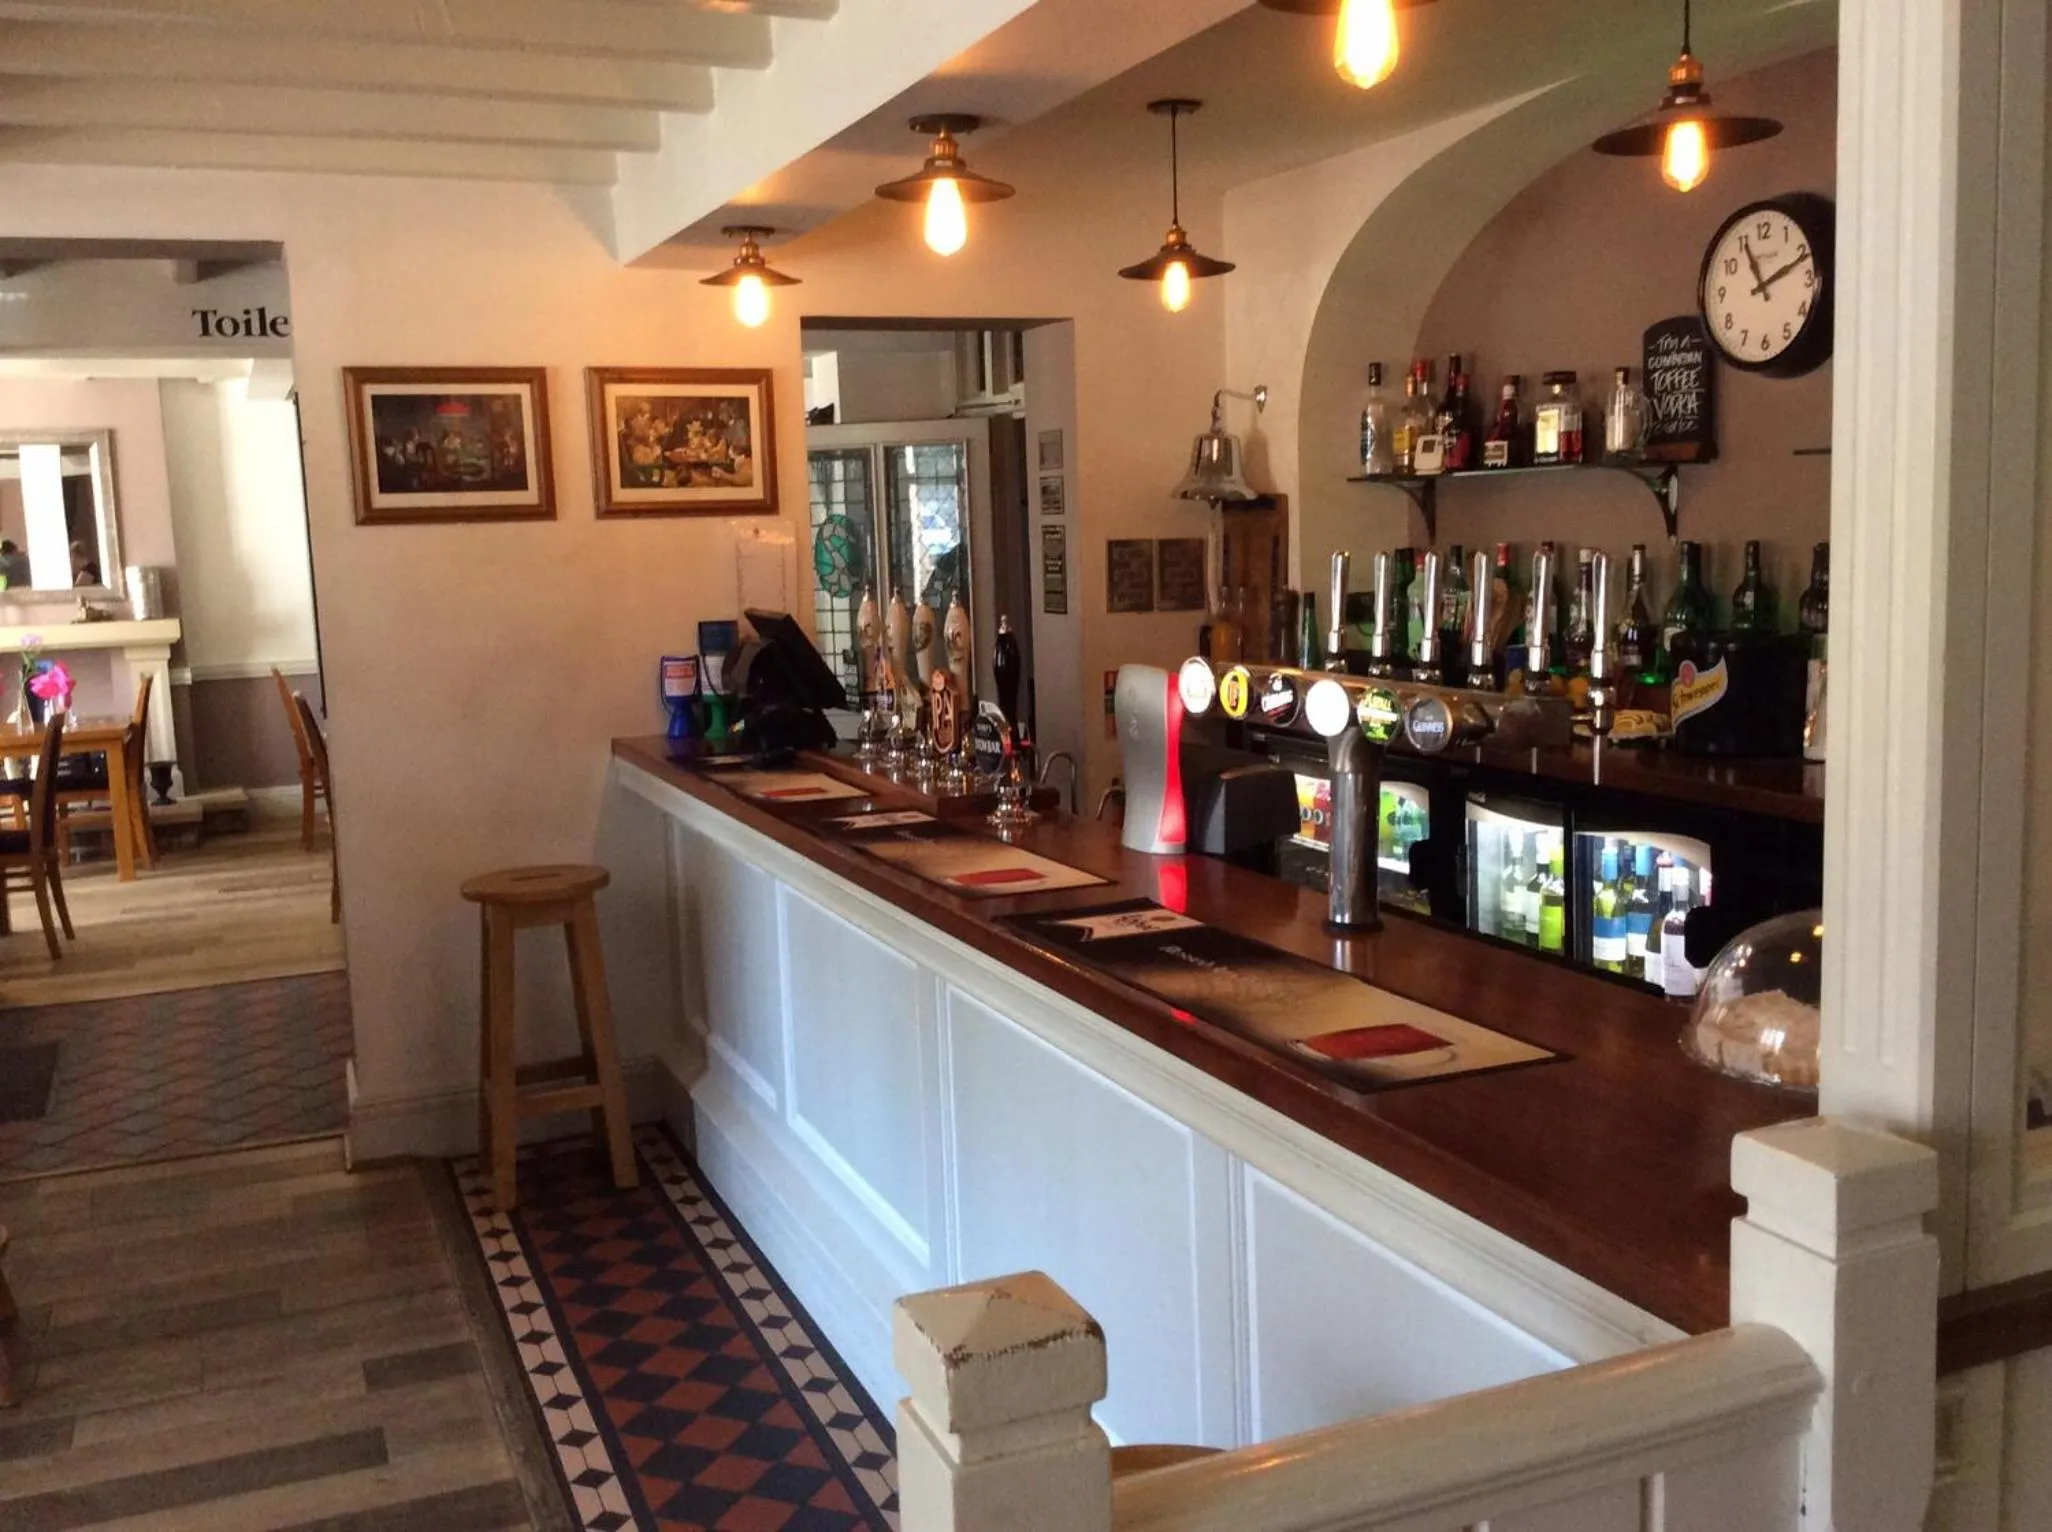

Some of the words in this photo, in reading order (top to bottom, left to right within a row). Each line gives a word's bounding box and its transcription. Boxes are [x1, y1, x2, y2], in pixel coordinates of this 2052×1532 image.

[1756, 222, 1772, 241] 12
[1783, 226, 1789, 244] 1
[1724, 258, 1738, 276] 10
[1804, 270, 1814, 288] 3
[1718, 286, 1727, 304] 9
[1797, 301, 1807, 318] 4
[191, 305, 290, 338] Toile
[1724, 312, 1733, 330] 8
[1740, 329, 1748, 347] 7
[1783, 322, 1792, 340] 5
[1760, 333, 1770, 351] 6
[1650, 366, 1703, 394] TOFFEE
[1653, 391, 1701, 420] VODKA
